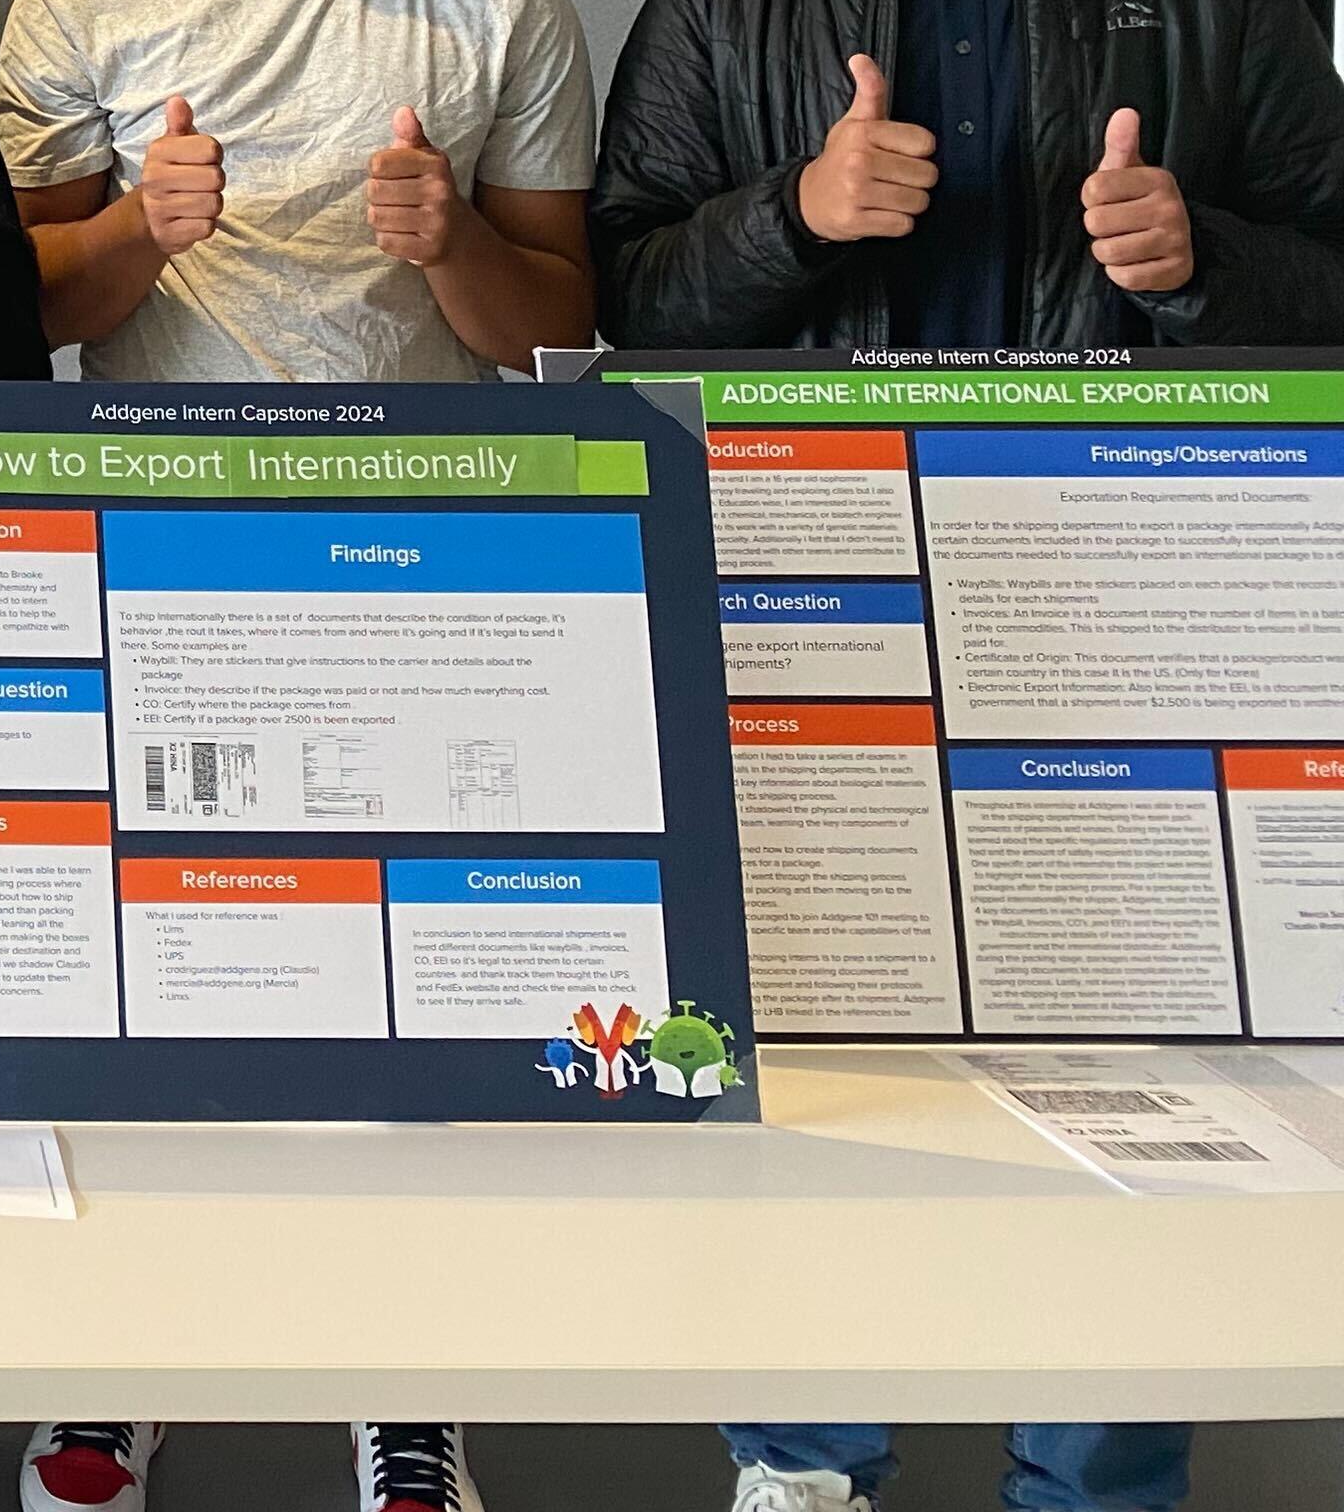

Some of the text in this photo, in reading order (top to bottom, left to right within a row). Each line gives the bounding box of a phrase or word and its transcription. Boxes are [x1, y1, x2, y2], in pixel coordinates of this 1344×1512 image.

[851, 346, 1131, 368] Addgene Intern Capstone 2024
[721, 383, 1269, 403] ADDGENE: INTERNATIONAL EXPORTATION
[91, 403, 384, 424] Addgene Intern Capstone 2024
[707, 441, 793, 457] oduction
[1091, 446, 1307, 465] Findings/Observations
[48, 447, 85, 476] to
[100, 446, 224, 485] Export
[249, 445, 516, 484] Internationally
[1060, 491, 1127, 503] Exportation
[1215, 492, 1238, 502] and
[330, 544, 420, 567] Findings
[753, 593, 840, 609] Question
[120, 641, 148, 649] there.
[151, 641, 180, 649] Some
[756, 641, 799, 653] export
[803, 640, 884, 651] international
[726, 657, 791, 670] hipments?
[142, 699, 161, 708] CO:
[163, 699, 196, 710] Certify
[197, 700, 228, 708] where
[231, 700, 247, 708] the
[249, 701, 291, 711] package
[328, 700, 354, 709] from
[729, 715, 799, 732] rocess
[1021, 760, 1130, 776] Conclusion
[182, 870, 297, 888] References
[467, 871, 580, 889] Conclusion
